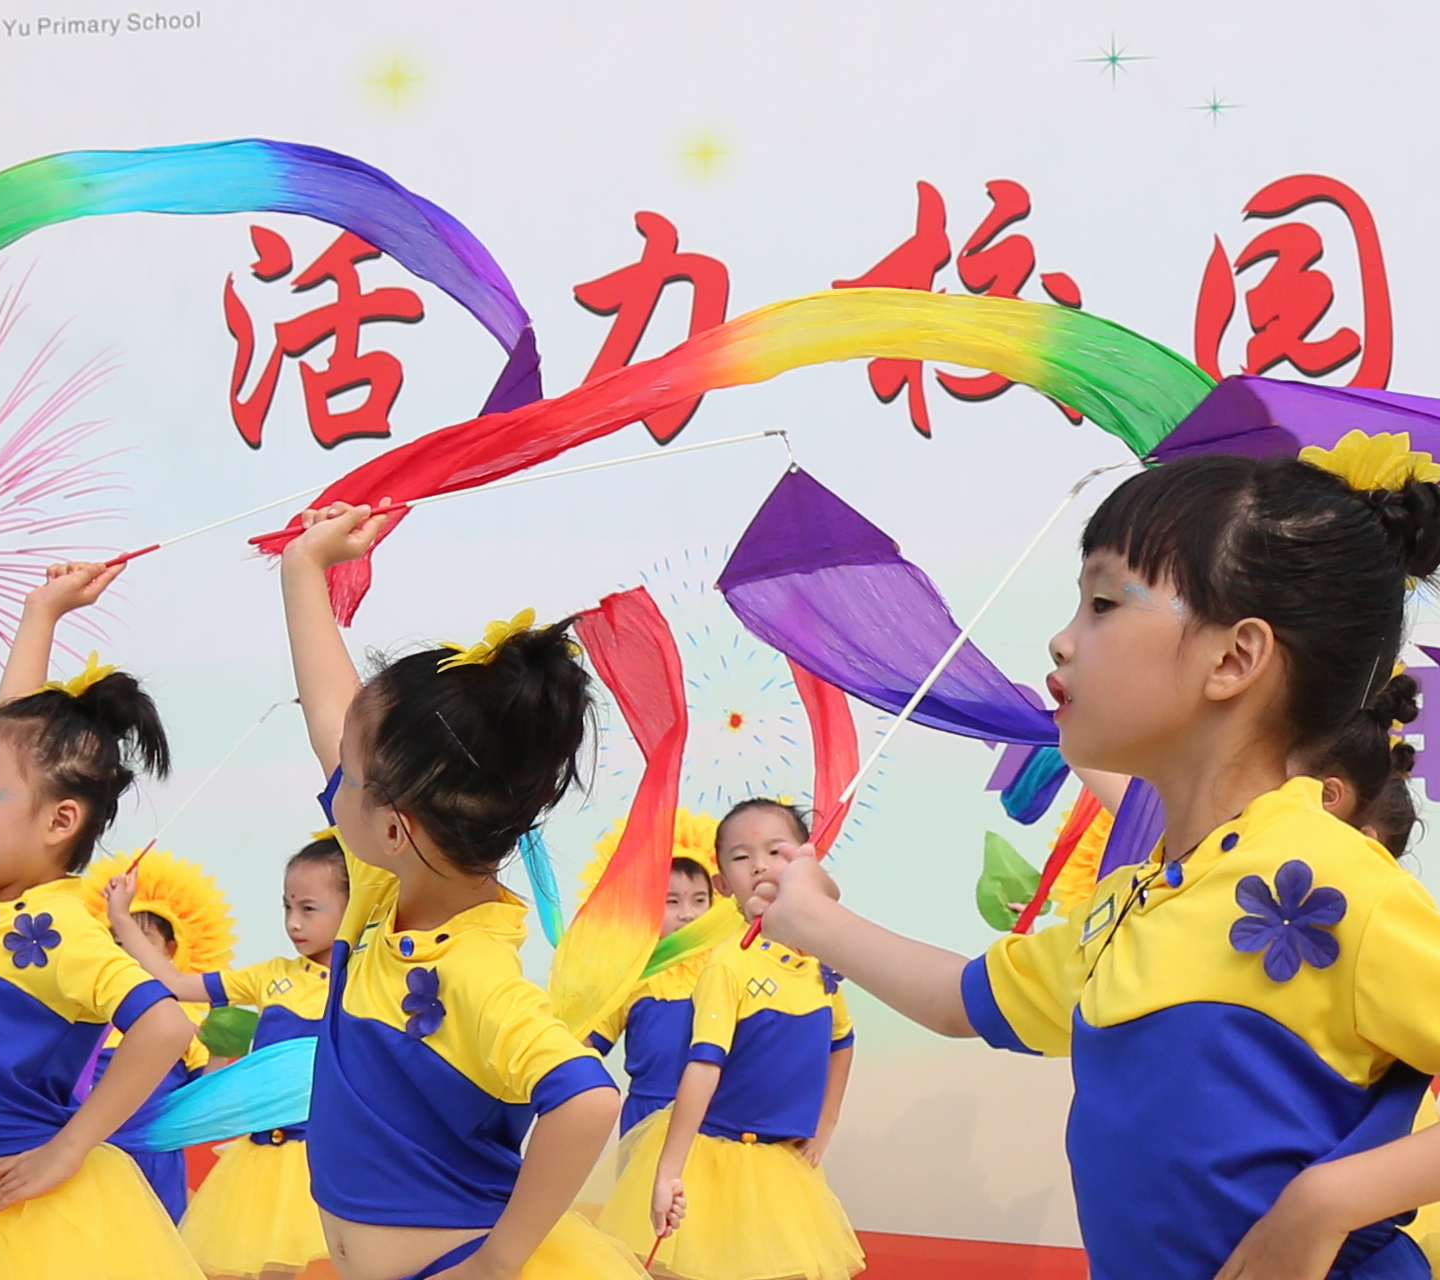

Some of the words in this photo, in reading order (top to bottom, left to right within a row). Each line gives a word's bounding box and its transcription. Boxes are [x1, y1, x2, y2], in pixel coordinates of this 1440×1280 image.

[2, 20, 31, 37] Yu
[38, 17, 121, 37] Primary
[127, 11, 201, 32] School
